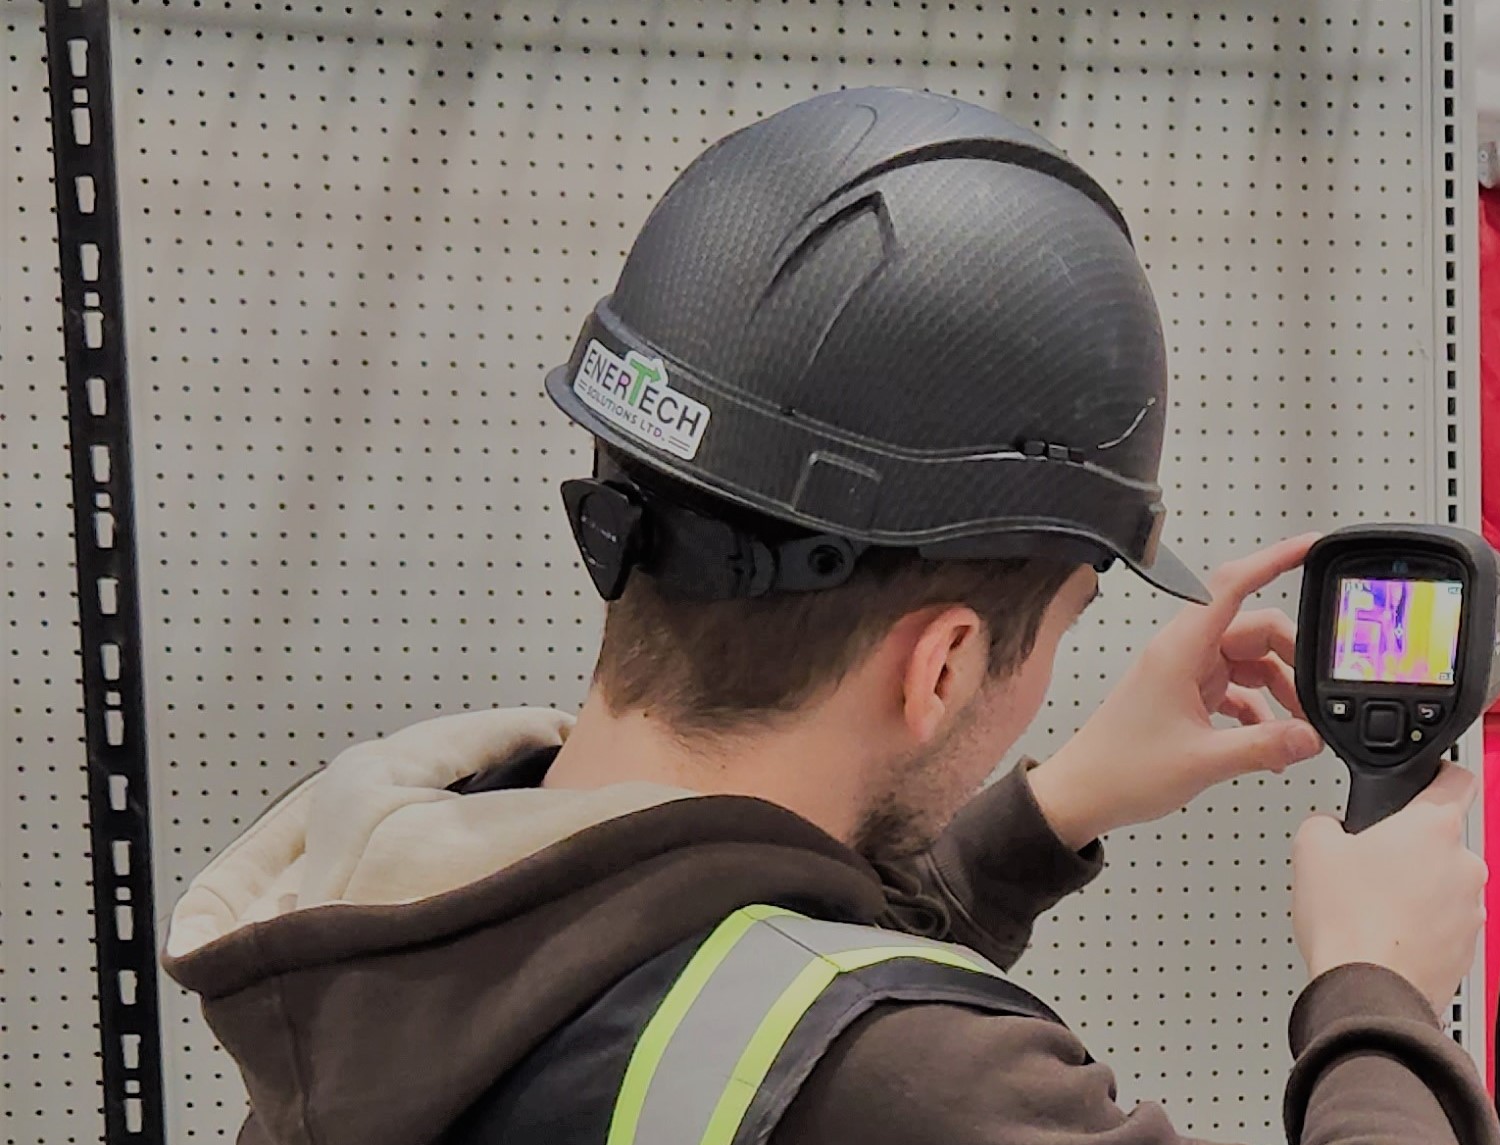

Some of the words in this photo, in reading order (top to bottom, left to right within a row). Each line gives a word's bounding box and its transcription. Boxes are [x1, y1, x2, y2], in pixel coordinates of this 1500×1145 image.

[583, 347, 702, 438] ENERTECH
[586, 385, 638, 426] SOLUTIONS
[639, 419, 666, 442] LTD.
